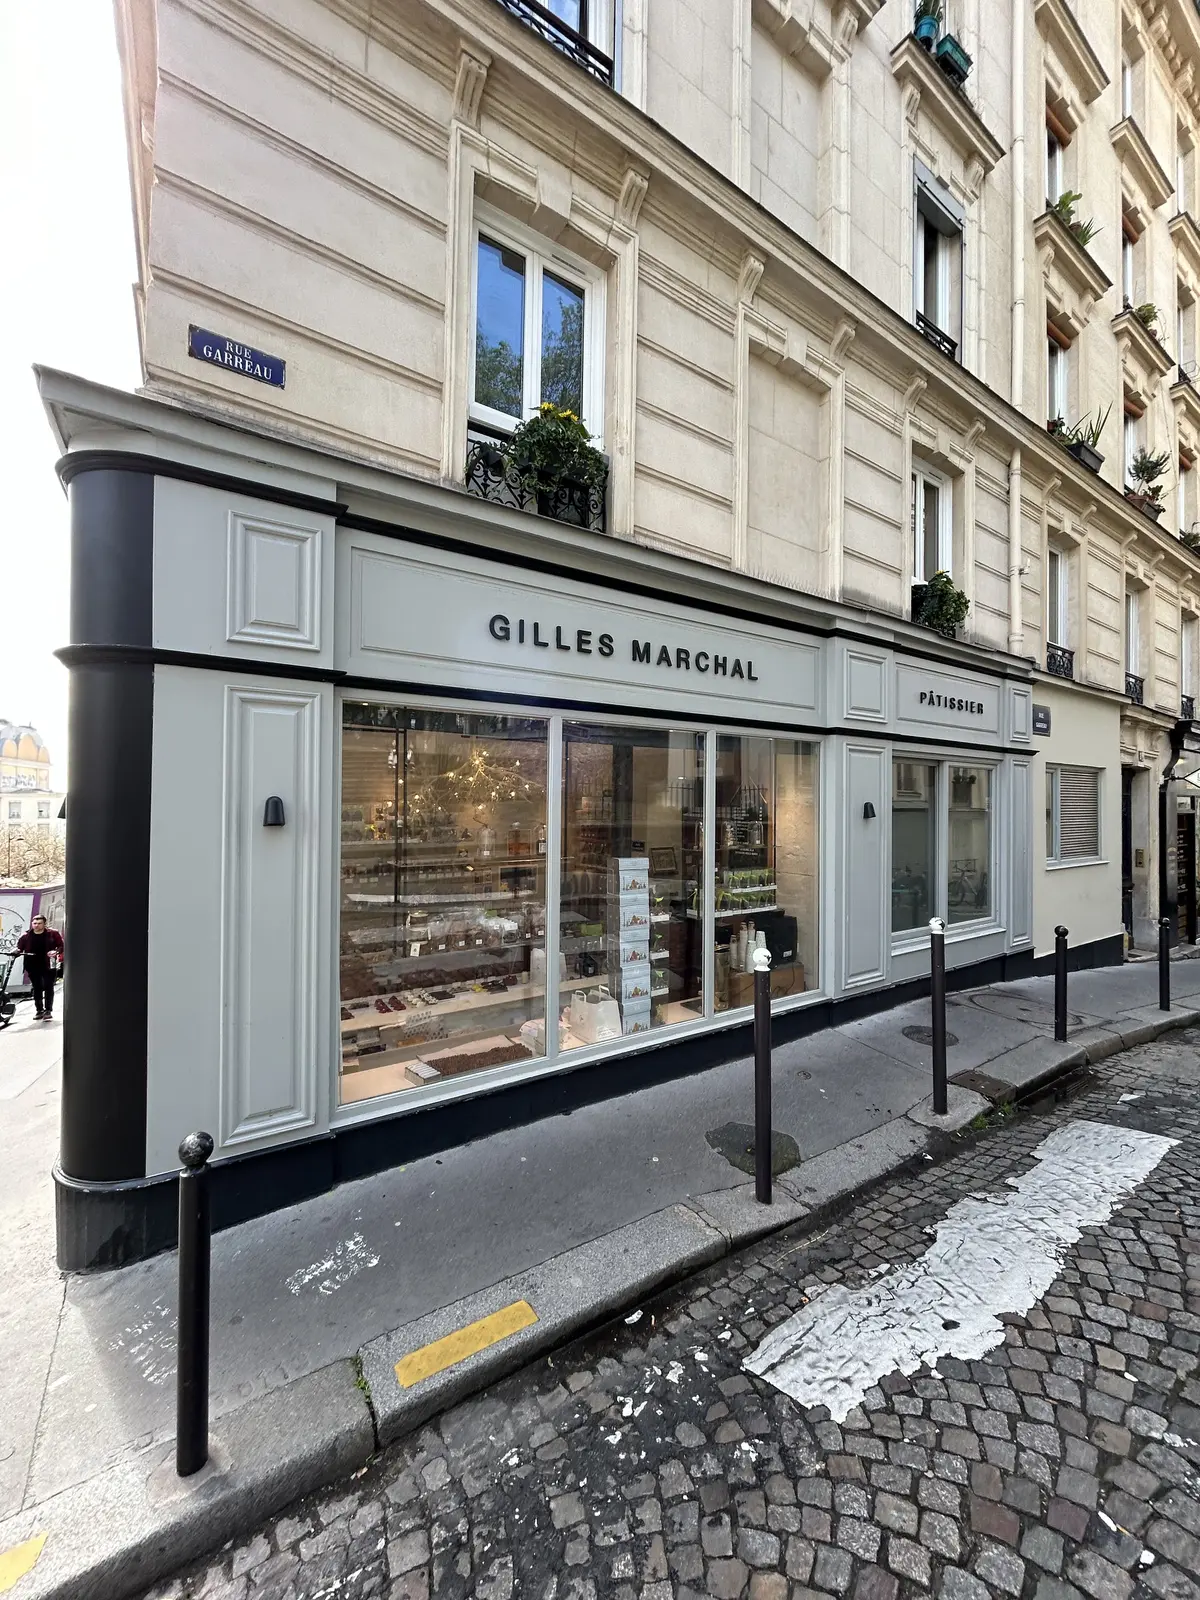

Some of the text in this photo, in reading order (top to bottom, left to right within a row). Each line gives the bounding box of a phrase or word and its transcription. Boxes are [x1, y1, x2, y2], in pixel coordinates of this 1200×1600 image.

[203, 345, 272, 380] GARREAU
[225, 340, 252, 359] RUE
[489, 614, 759, 681] GILLES MARCHAL
[919, 690, 984, 714] PÂTISSIER
